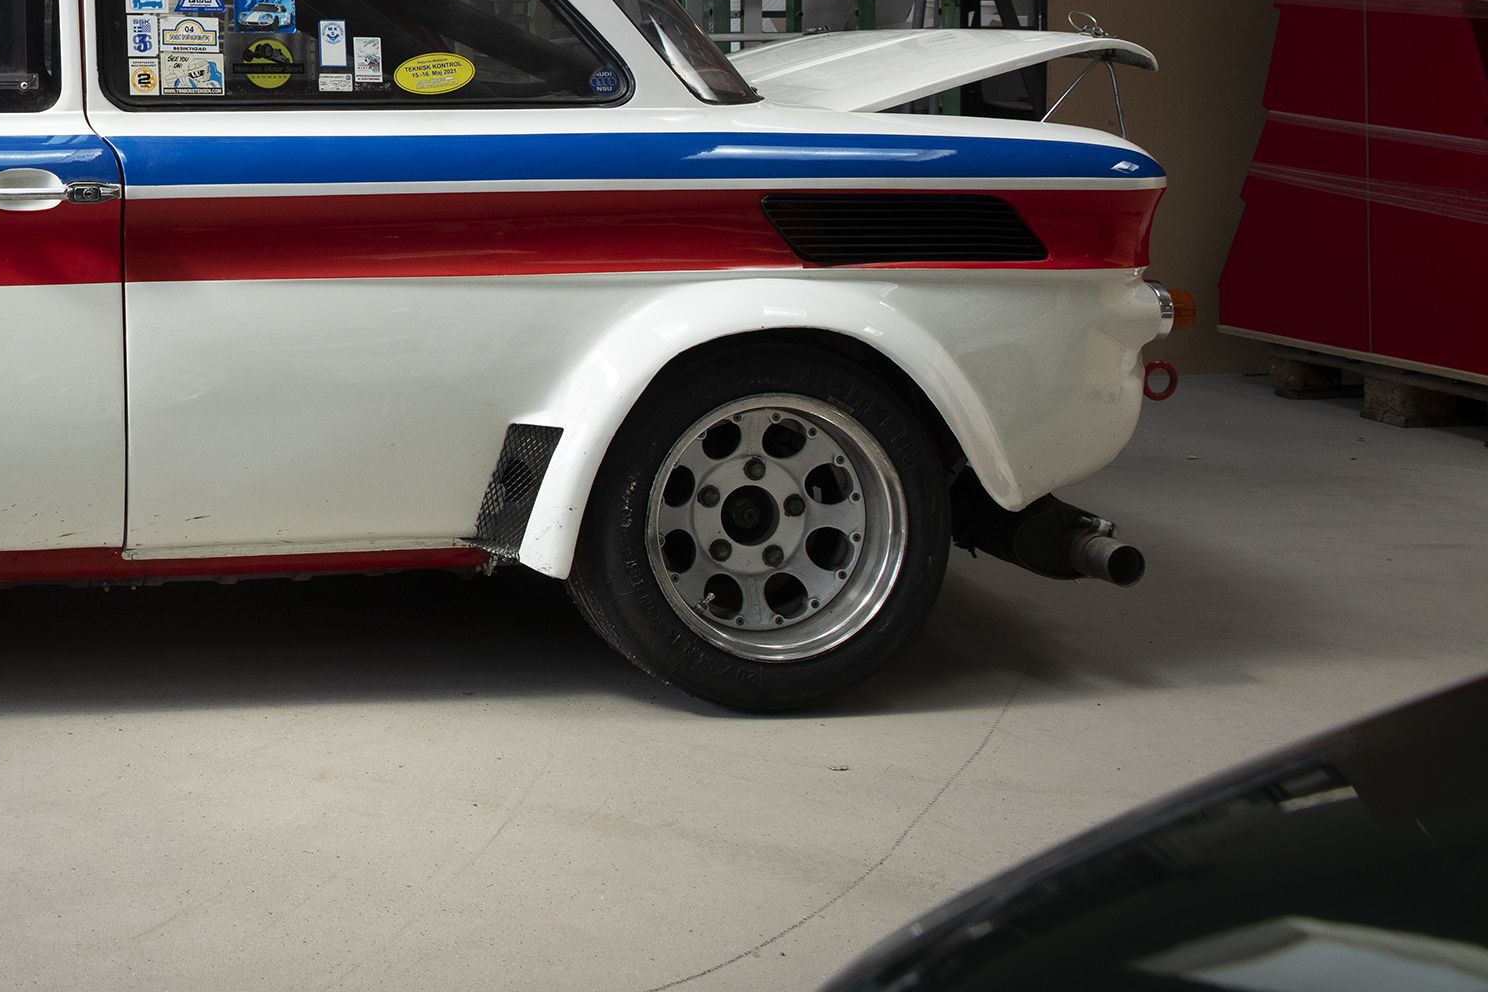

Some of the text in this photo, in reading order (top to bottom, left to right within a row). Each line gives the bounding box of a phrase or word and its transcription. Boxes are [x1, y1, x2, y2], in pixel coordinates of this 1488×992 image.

[184, 25, 194, 33] 04
[405, 65, 432, 73] TEKNISK
[432, 61, 463, 69] KONTROL
[137, 73, 152, 85] 2
